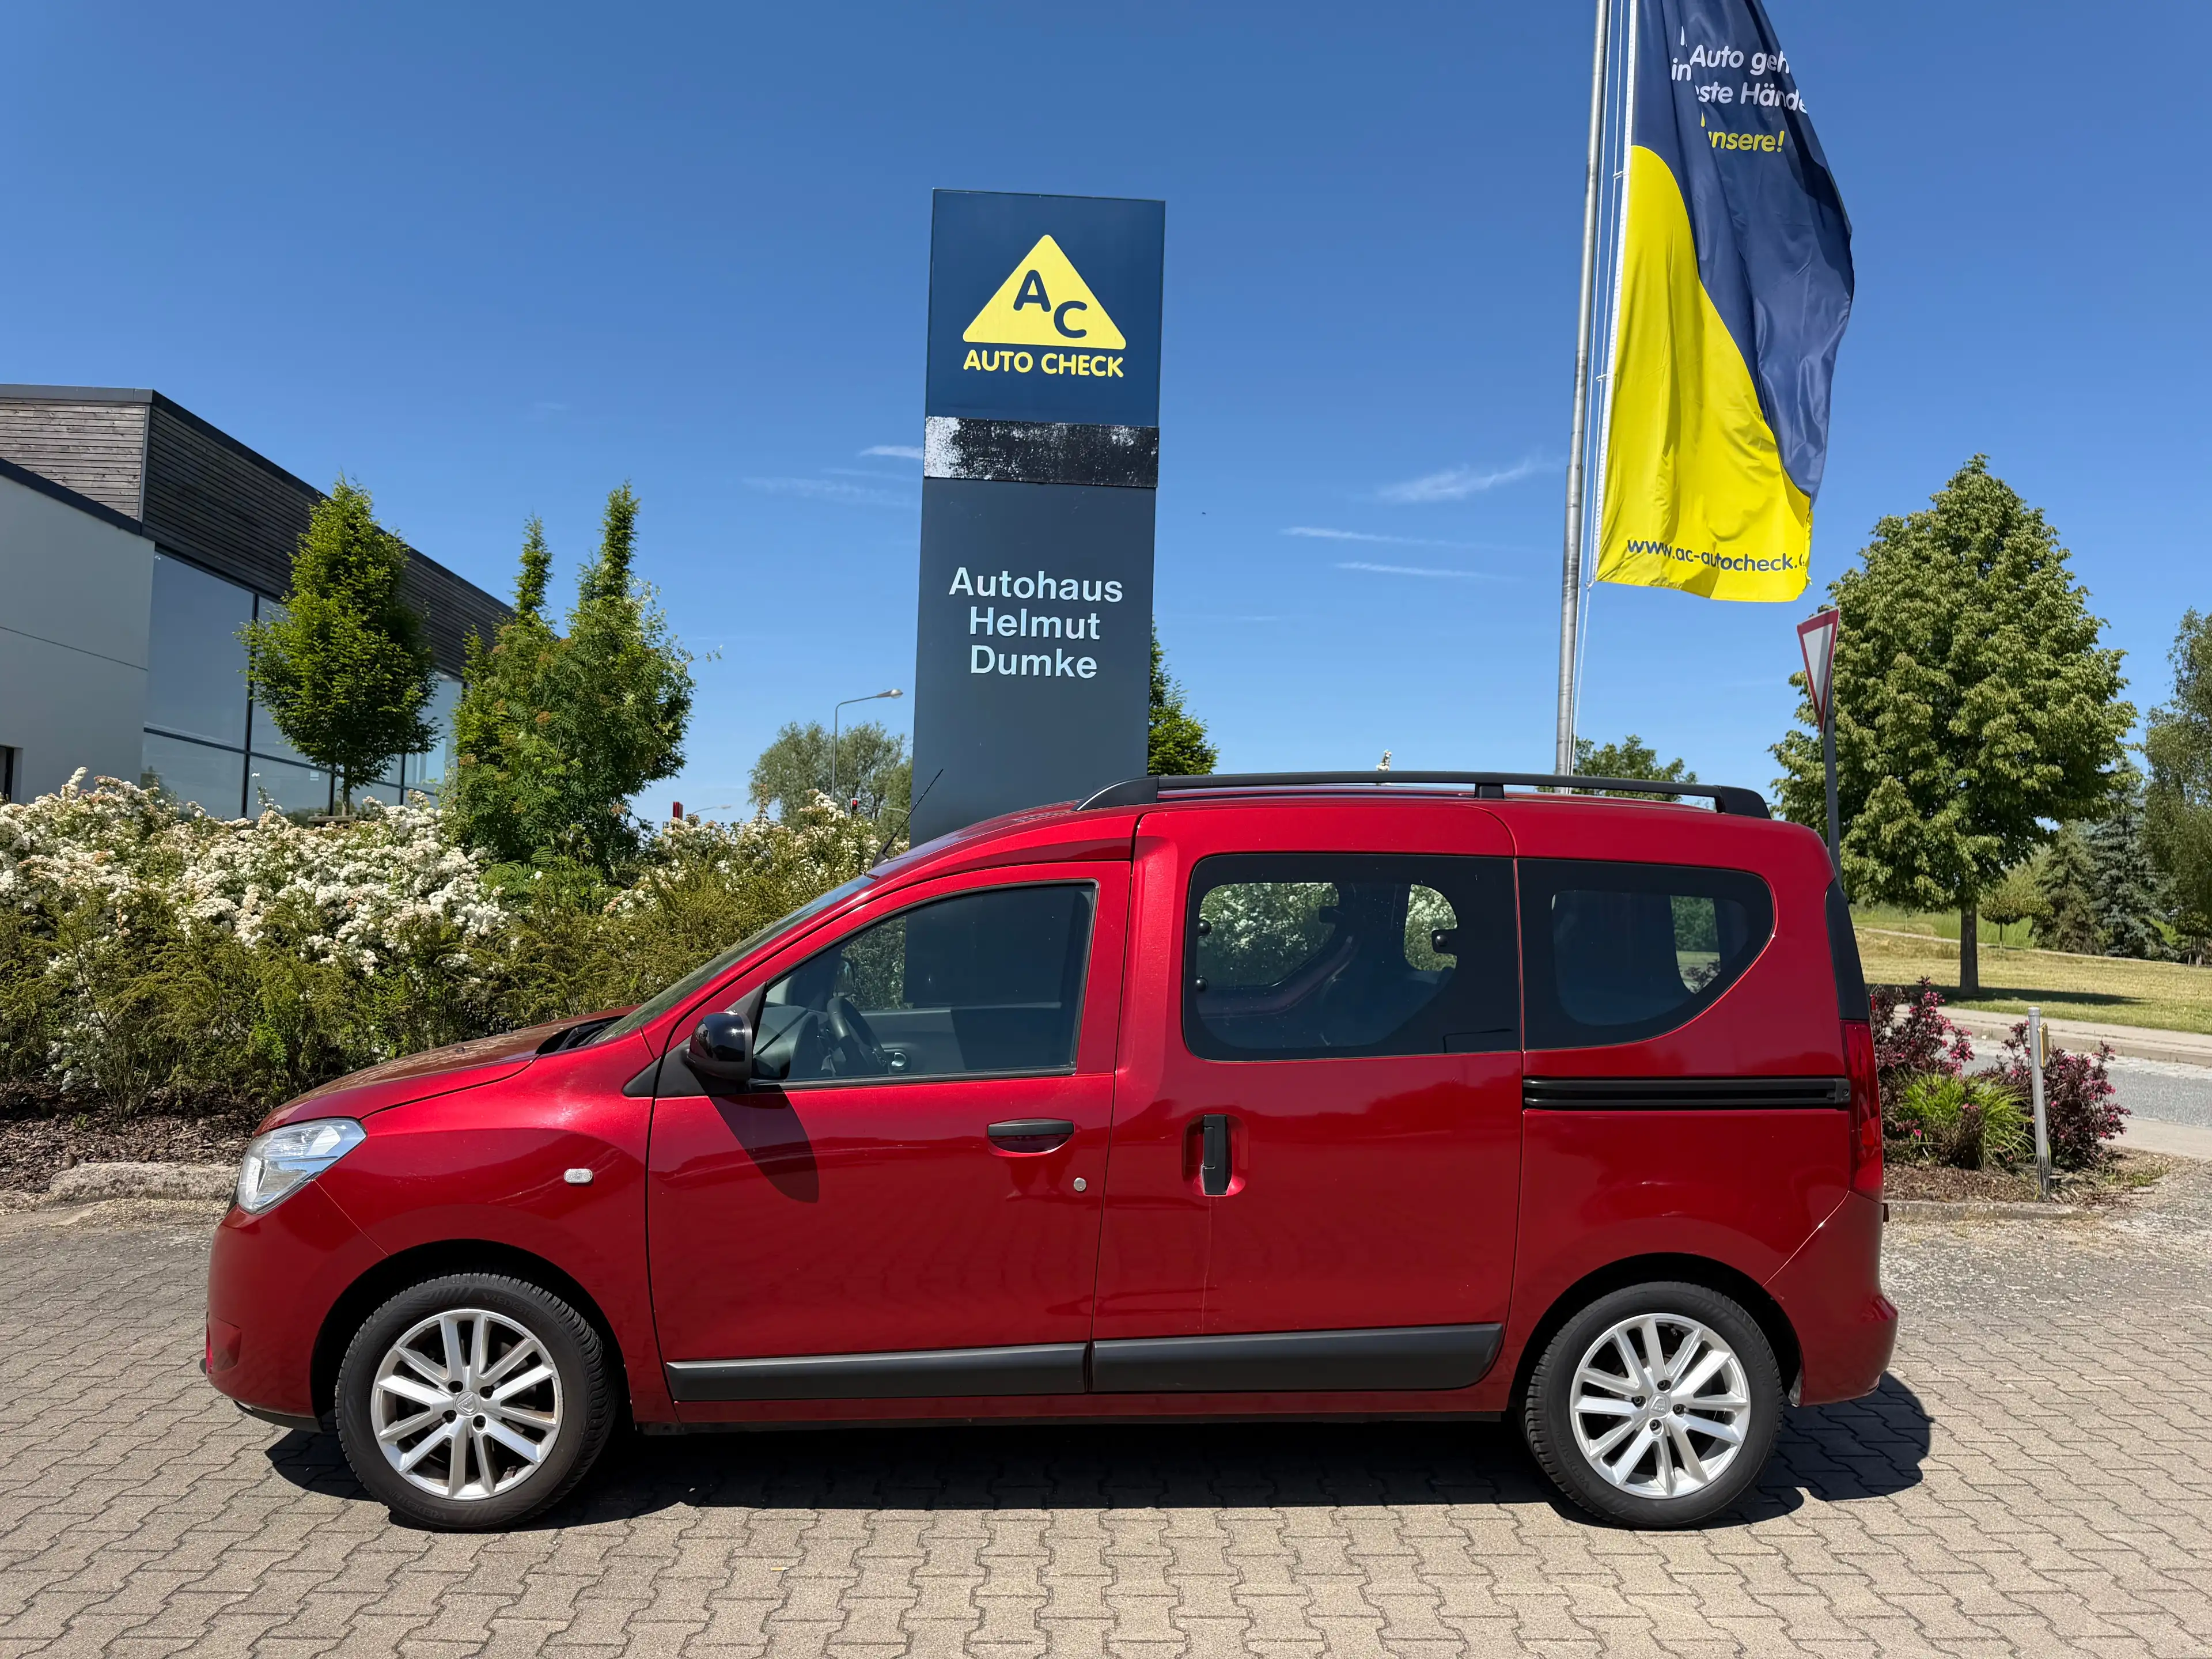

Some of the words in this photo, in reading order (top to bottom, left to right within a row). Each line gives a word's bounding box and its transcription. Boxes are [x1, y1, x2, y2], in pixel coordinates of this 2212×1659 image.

[1690, 44, 1744, 69] Auto
[1671, 58, 1692, 81] in
[1695, 81, 1733, 104] ste
[1013, 270, 1088, 339] AC
[963, 349, 1033, 373] AUTO
[1041, 353, 1124, 378] CHECK
[949, 567, 1123, 603] Autohaus
[969, 606, 1101, 640] Helmut
[971, 645, 1097, 679] Dumke
